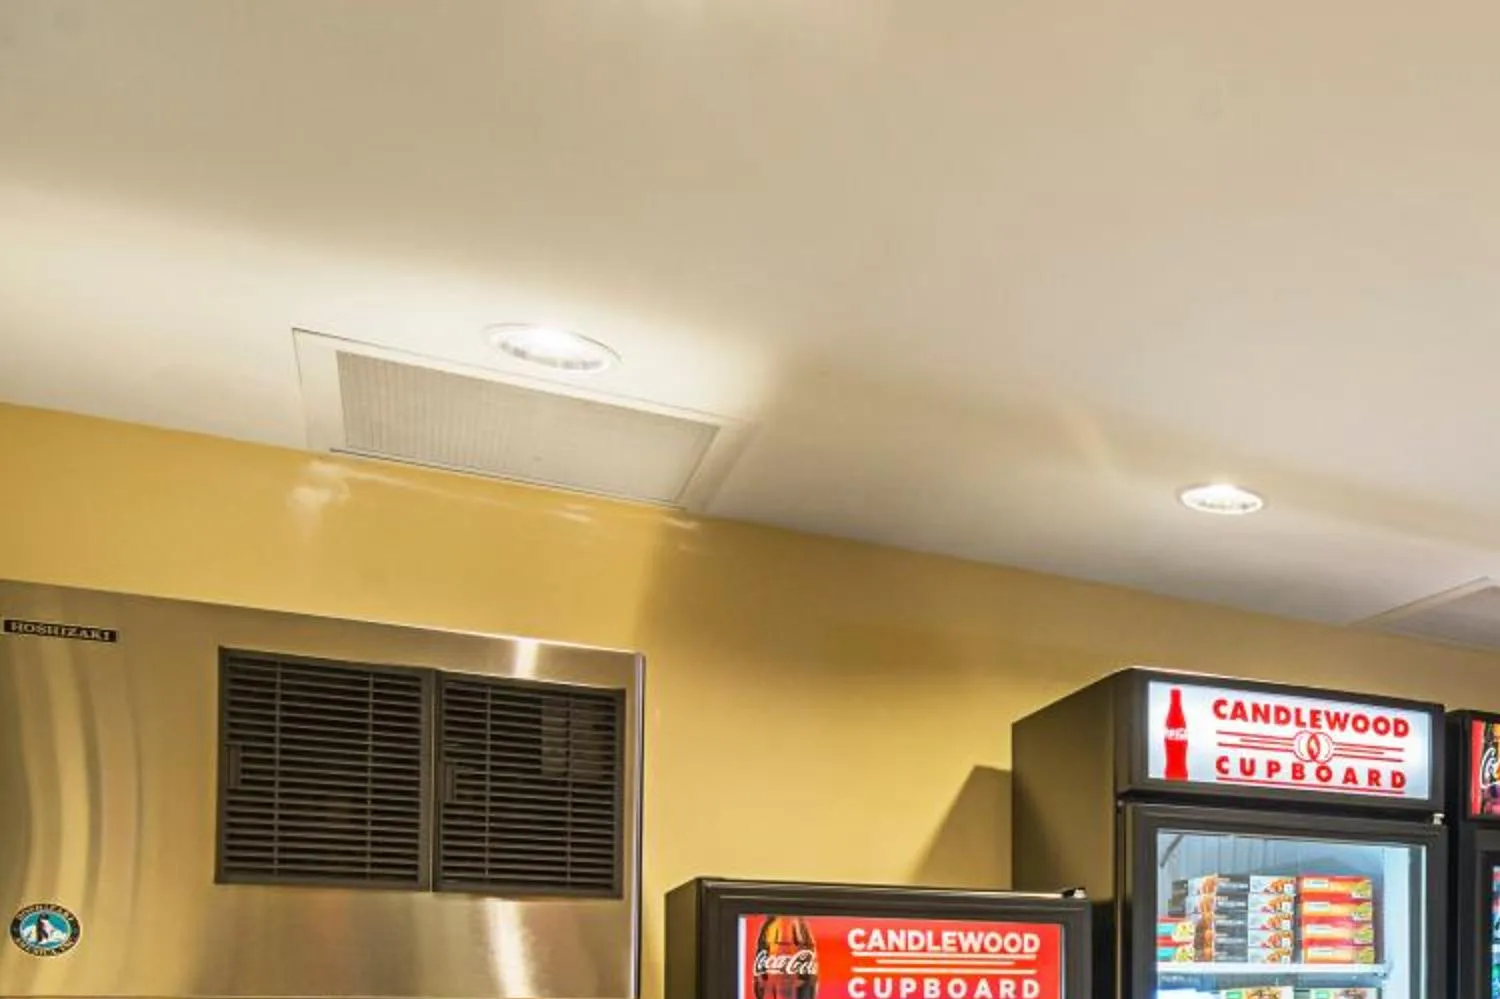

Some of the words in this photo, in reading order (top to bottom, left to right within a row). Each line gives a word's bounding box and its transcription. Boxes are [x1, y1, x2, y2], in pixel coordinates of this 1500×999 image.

[11, 621, 110, 641] HOSHIZAKI
[1212, 698, 1410, 738] CANDLEWOOD
[1215, 755, 1406, 789] CUPBOARD
[847, 928, 1041, 954] CANDLEWOOD
